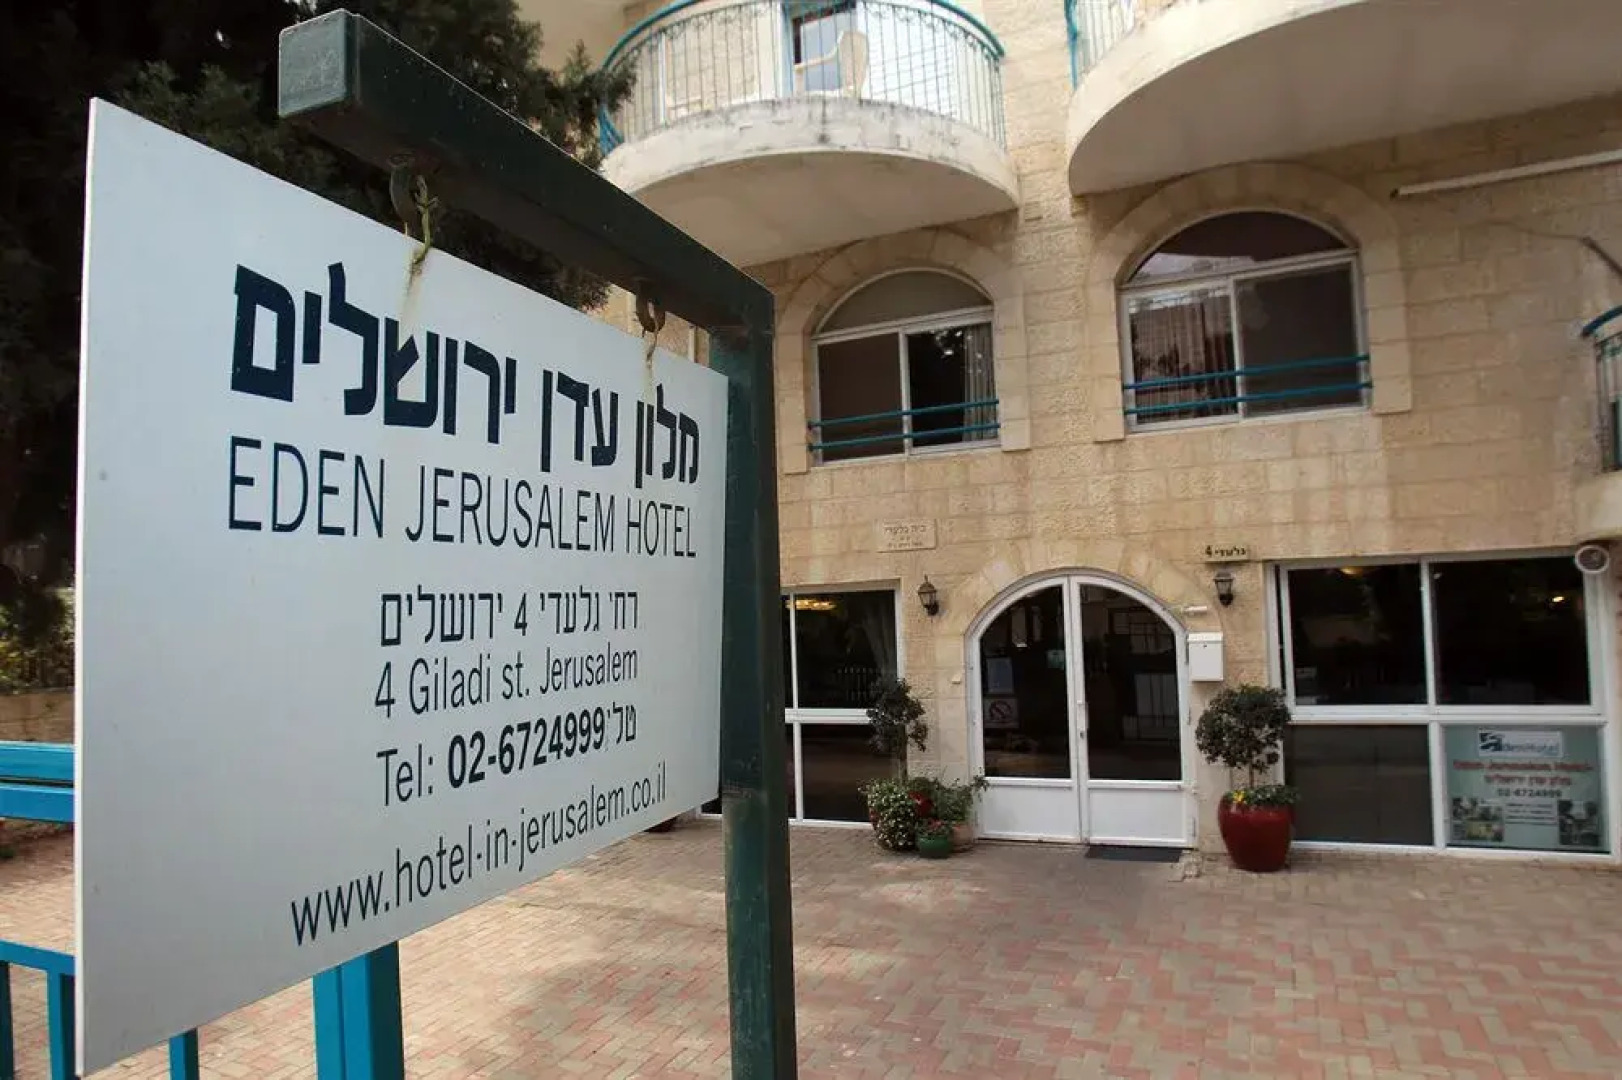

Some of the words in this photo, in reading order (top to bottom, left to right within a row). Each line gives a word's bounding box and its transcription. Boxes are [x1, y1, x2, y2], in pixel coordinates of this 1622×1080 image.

[231, 262, 516, 444] ירושלים
[540, 369, 619, 472] עדן
[635, 383, 700, 488] מלון
[228, 435, 385, 538] EDEN
[405, 465, 615, 553] JERUSALEM
[626, 500, 697, 558] HOTEL
[380, 584, 504, 647] ירושלים
[513, 592, 528, 636] 4
[540, 585, 600, 633] גלעדי
[374, 661, 396, 718] 4
[409, 653, 491, 715] Giladi
[501, 651, 530, 699] st.
[539, 642, 638, 695] Jerusalem
[376, 743, 433, 807] Tel:
[447, 706, 604, 788] 02-6724999
